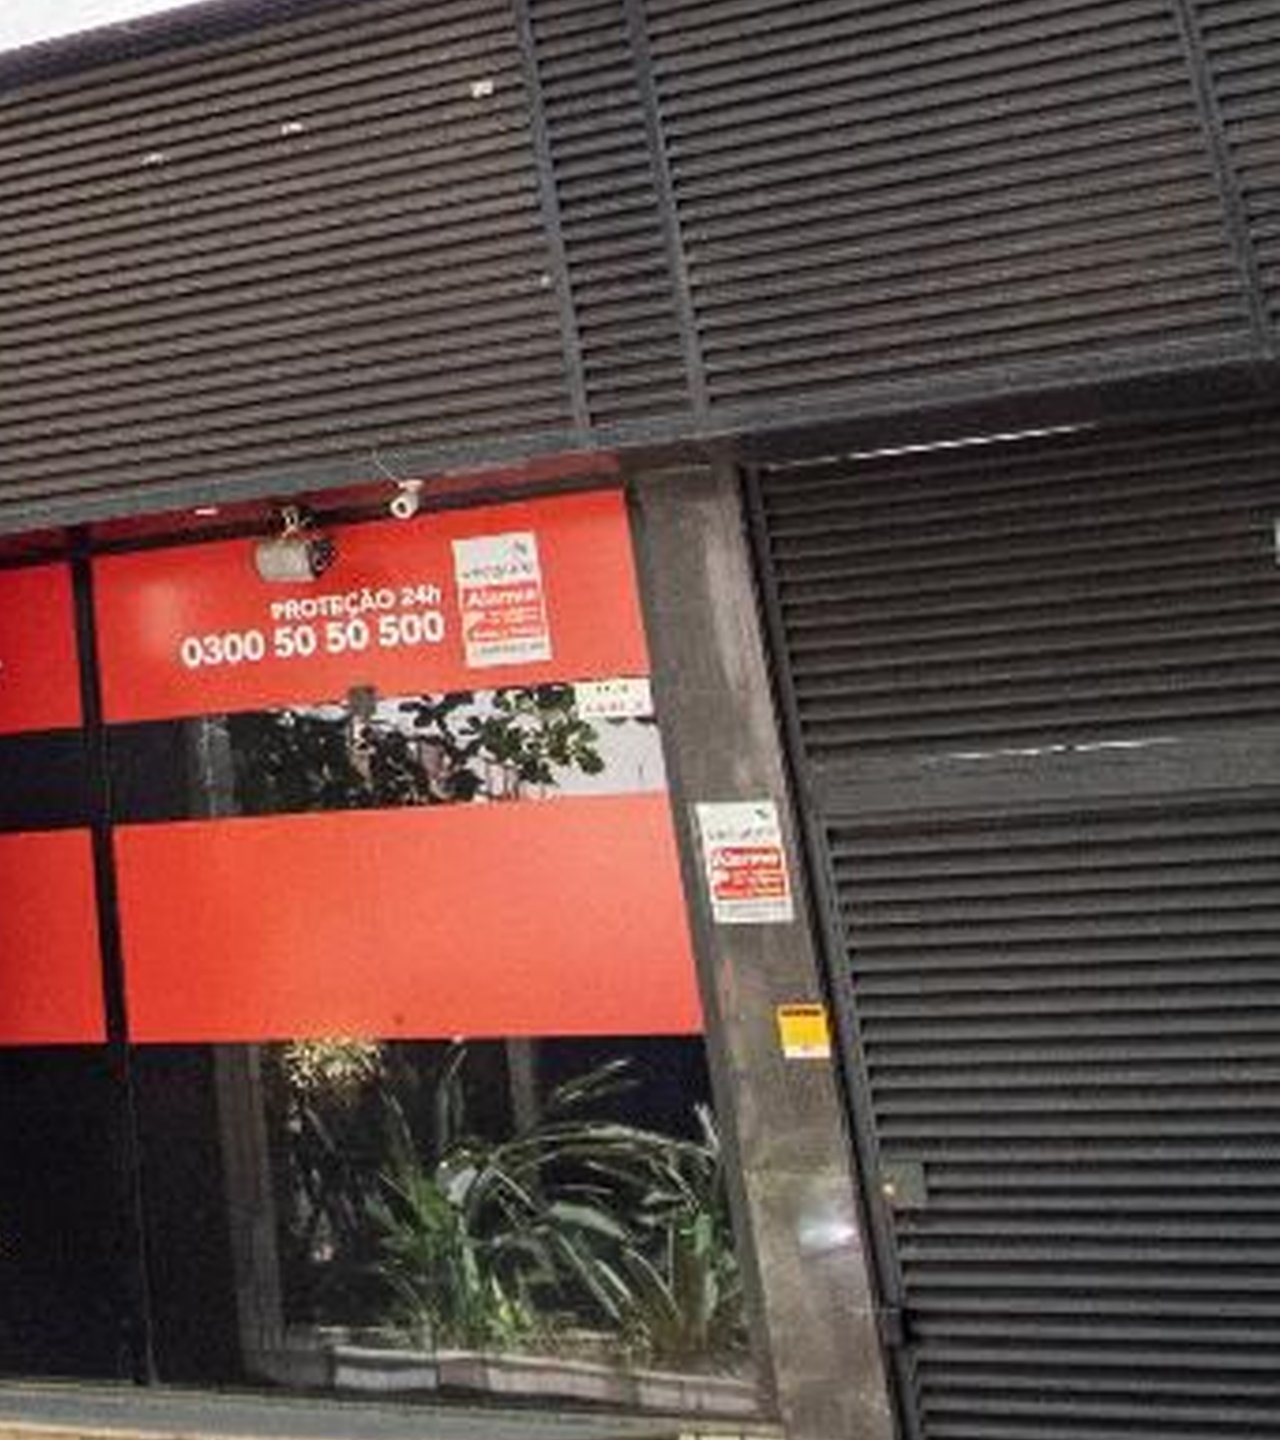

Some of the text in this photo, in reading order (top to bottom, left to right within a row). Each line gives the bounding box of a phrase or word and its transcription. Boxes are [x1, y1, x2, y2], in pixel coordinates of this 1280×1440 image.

[270, 584, 441, 621] PROTEÇÃO 24h
[180, 629, 266, 668] 0300
[273, 624, 316, 658] 50
[326, 618, 369, 653] 50
[377, 610, 445, 647] 500
